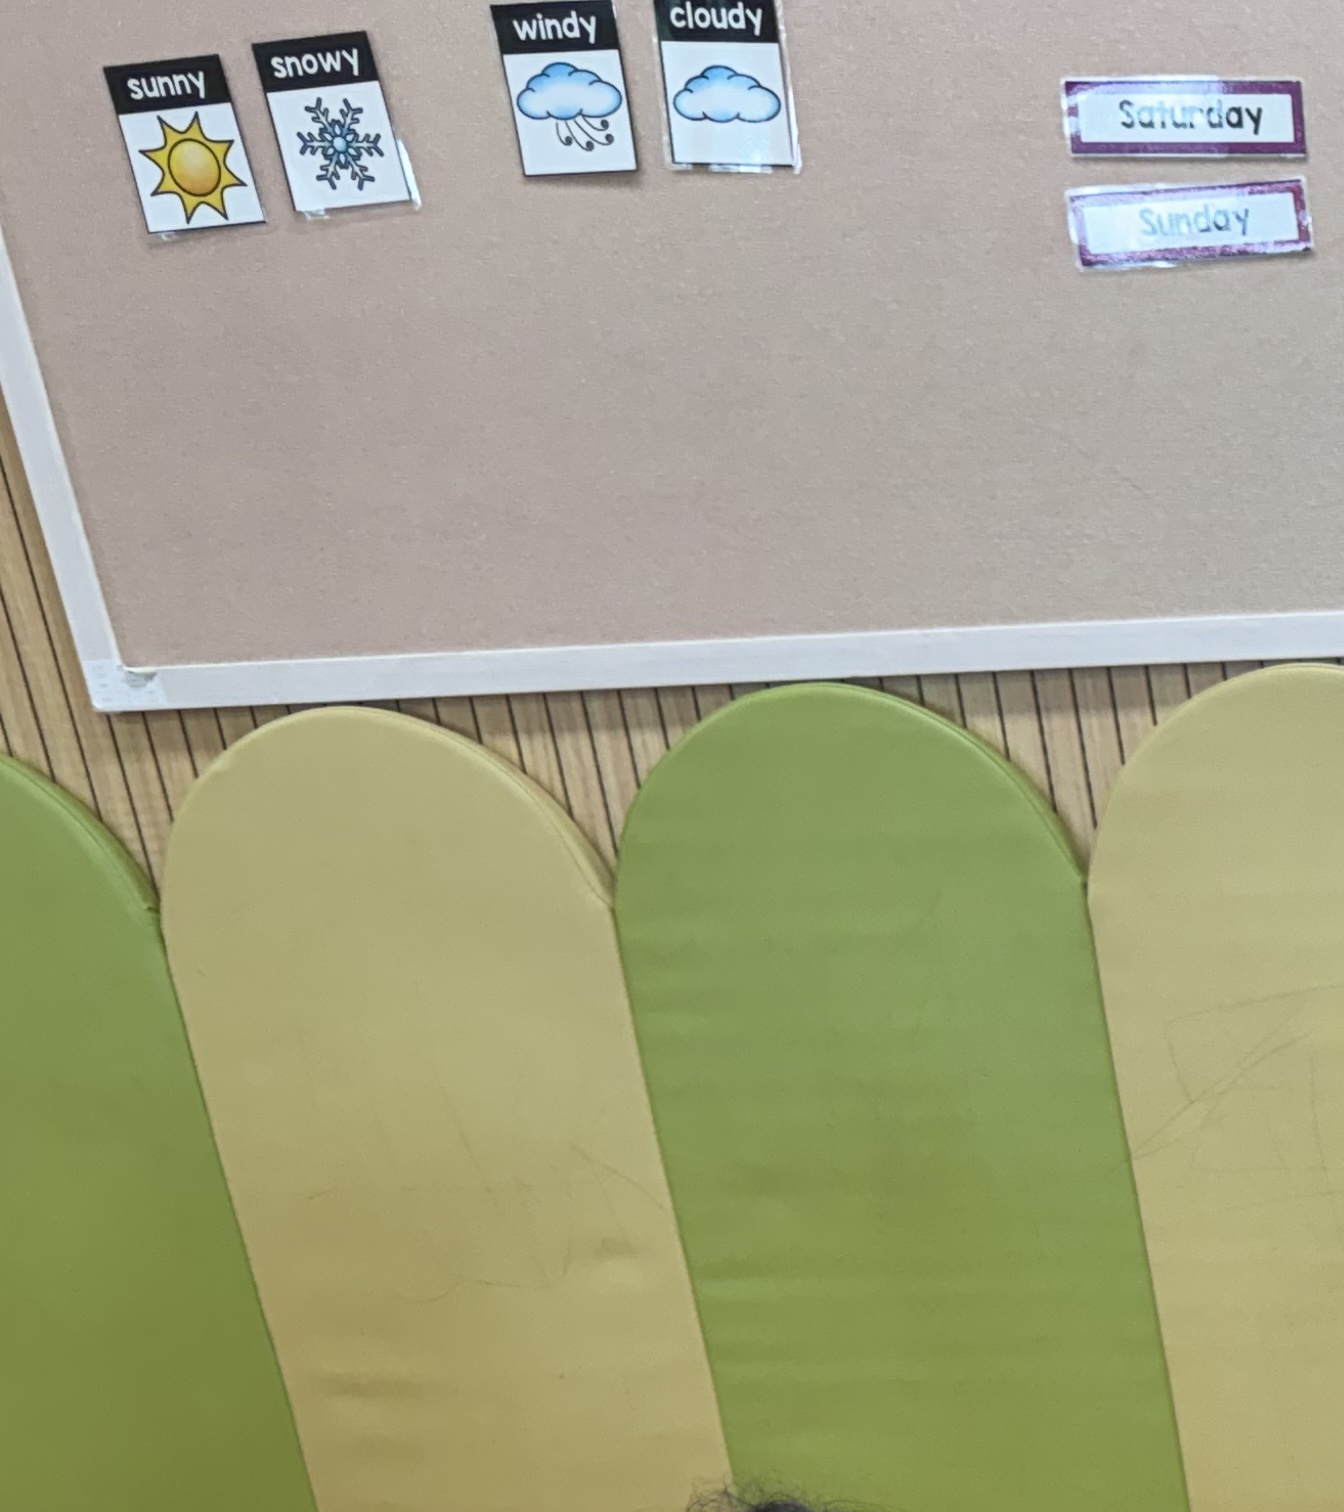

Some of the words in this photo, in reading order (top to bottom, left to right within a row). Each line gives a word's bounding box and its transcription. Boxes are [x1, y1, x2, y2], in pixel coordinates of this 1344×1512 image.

[512, 11, 598, 44] windy
[669, 1, 764, 35] cloudy
[271, 47, 361, 83] snowy
[127, 70, 205, 101] sunny
[1117, 99, 1264, 135] Saturday
[1139, 204, 1250, 238] Sunday
